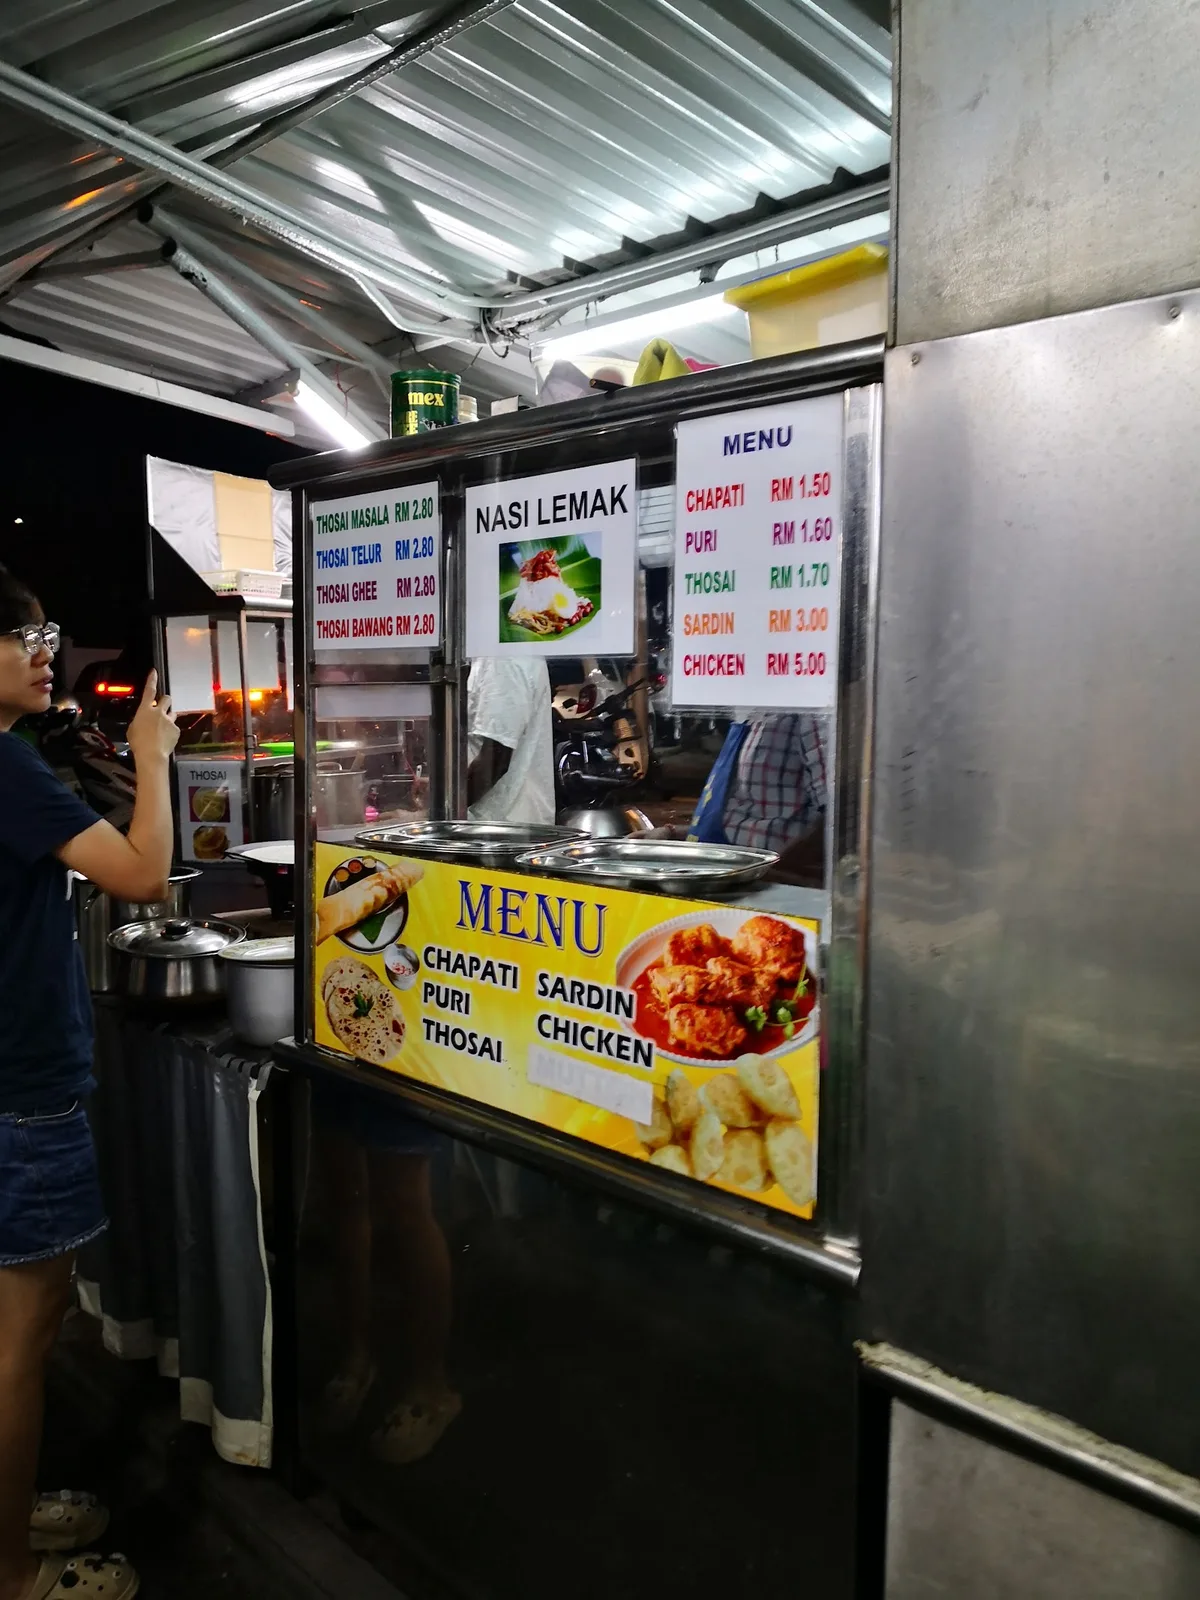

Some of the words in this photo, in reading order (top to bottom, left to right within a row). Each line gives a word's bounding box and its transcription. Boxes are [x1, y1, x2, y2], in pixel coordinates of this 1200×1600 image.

[723, 425, 793, 456] MENU
[476, 500, 529, 534] NASI
[538, 484, 629, 526] LEMAK
[686, 483, 745, 512] CHAPATI
[771, 475, 794, 502] RM
[799, 472, 832, 499] 1.50
[316, 512, 349, 534] THOSAI
[351, 505, 389, 529] MASALA
[395, 501, 410, 523] RM
[413, 497, 434, 520] 2.80
[316, 547, 349, 569] THOSAI
[351, 543, 382, 566] TELUR
[395, 539, 410, 561] RM
[413, 536, 434, 559] 2.80
[685, 529, 717, 554] PURI
[773, 521, 795, 546] RM
[801, 517, 833, 543] 1.60
[316, 583, 350, 604] THOSAI
[352, 580, 378, 602] GHEE
[396, 577, 412, 598] RM
[414, 575, 436, 597] 2.80
[685, 569, 736, 595] THOSAI
[770, 565, 793, 590] RM
[798, 563, 830, 588] 1.70
[316, 619, 350, 639] THOSAI
[352, 616, 393, 638] BAWANG
[396, 615, 411, 636] RM
[413, 613, 435, 635] 2.80
[683, 611, 735, 636] SARDIN
[768, 609, 792, 633] RM
[796, 607, 829, 632] 3.00
[683, 653, 745, 676] CHICKEN
[767, 653, 789, 676] RM
[794, 652, 826, 676] 5.00
[190, 770, 227, 781] THOSAI
[456, 879, 608, 958] MENU
[423, 945, 519, 990] CHAPATI
[423, 981, 471, 1016] PURI
[537, 973, 635, 1019] SARDIN
[422, 1018, 504, 1064] THOSAI
[537, 1014, 654, 1068] CHICKEN
